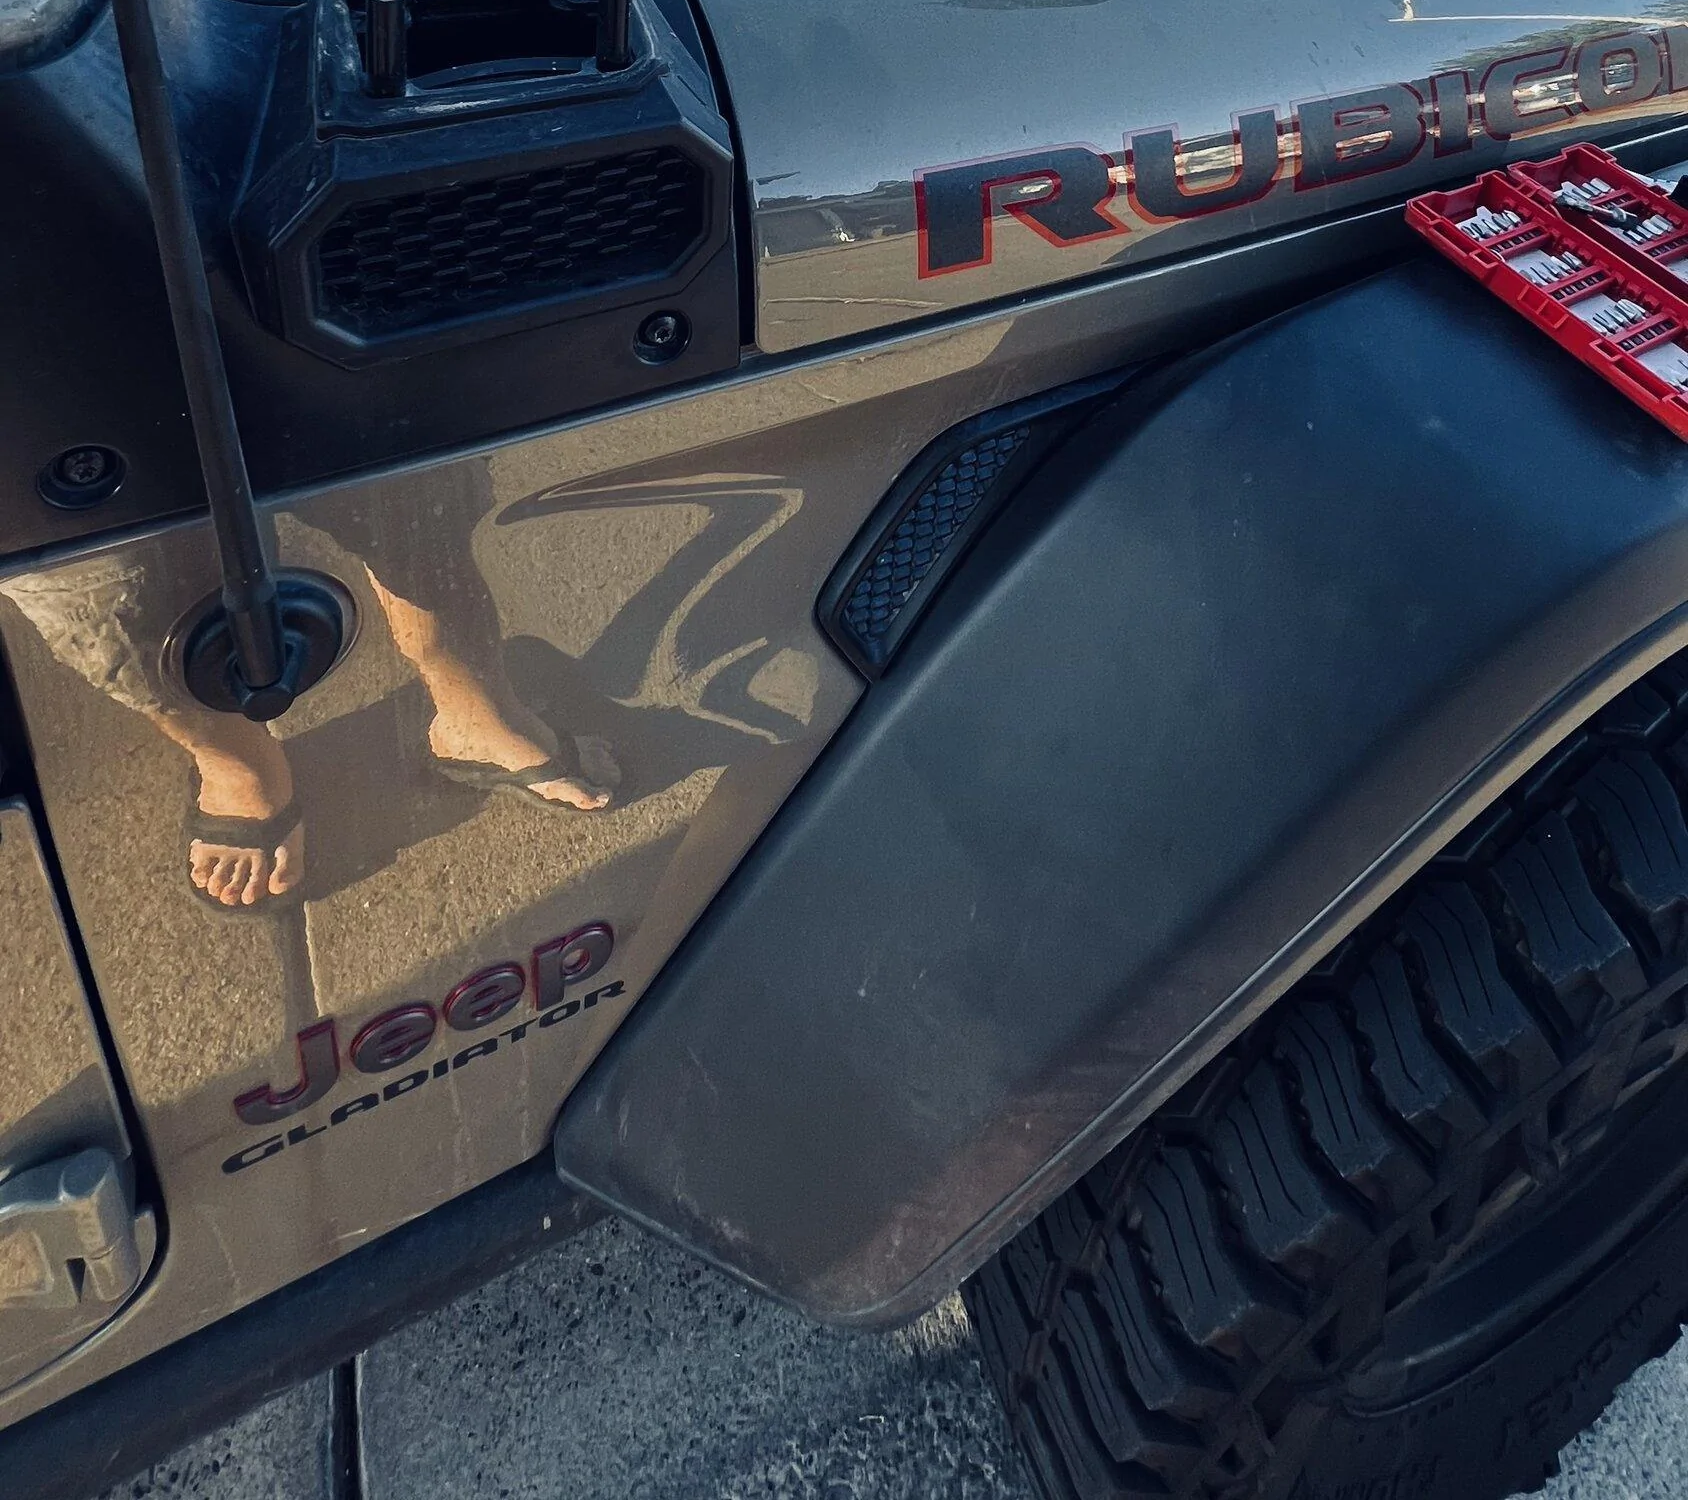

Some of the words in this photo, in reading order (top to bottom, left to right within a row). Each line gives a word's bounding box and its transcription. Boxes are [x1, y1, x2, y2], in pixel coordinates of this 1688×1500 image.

[913, 25, 1688, 280] RUBICO
[221, 979, 627, 1174] GLADIATOR
[233, 921, 614, 1125] Jeep
